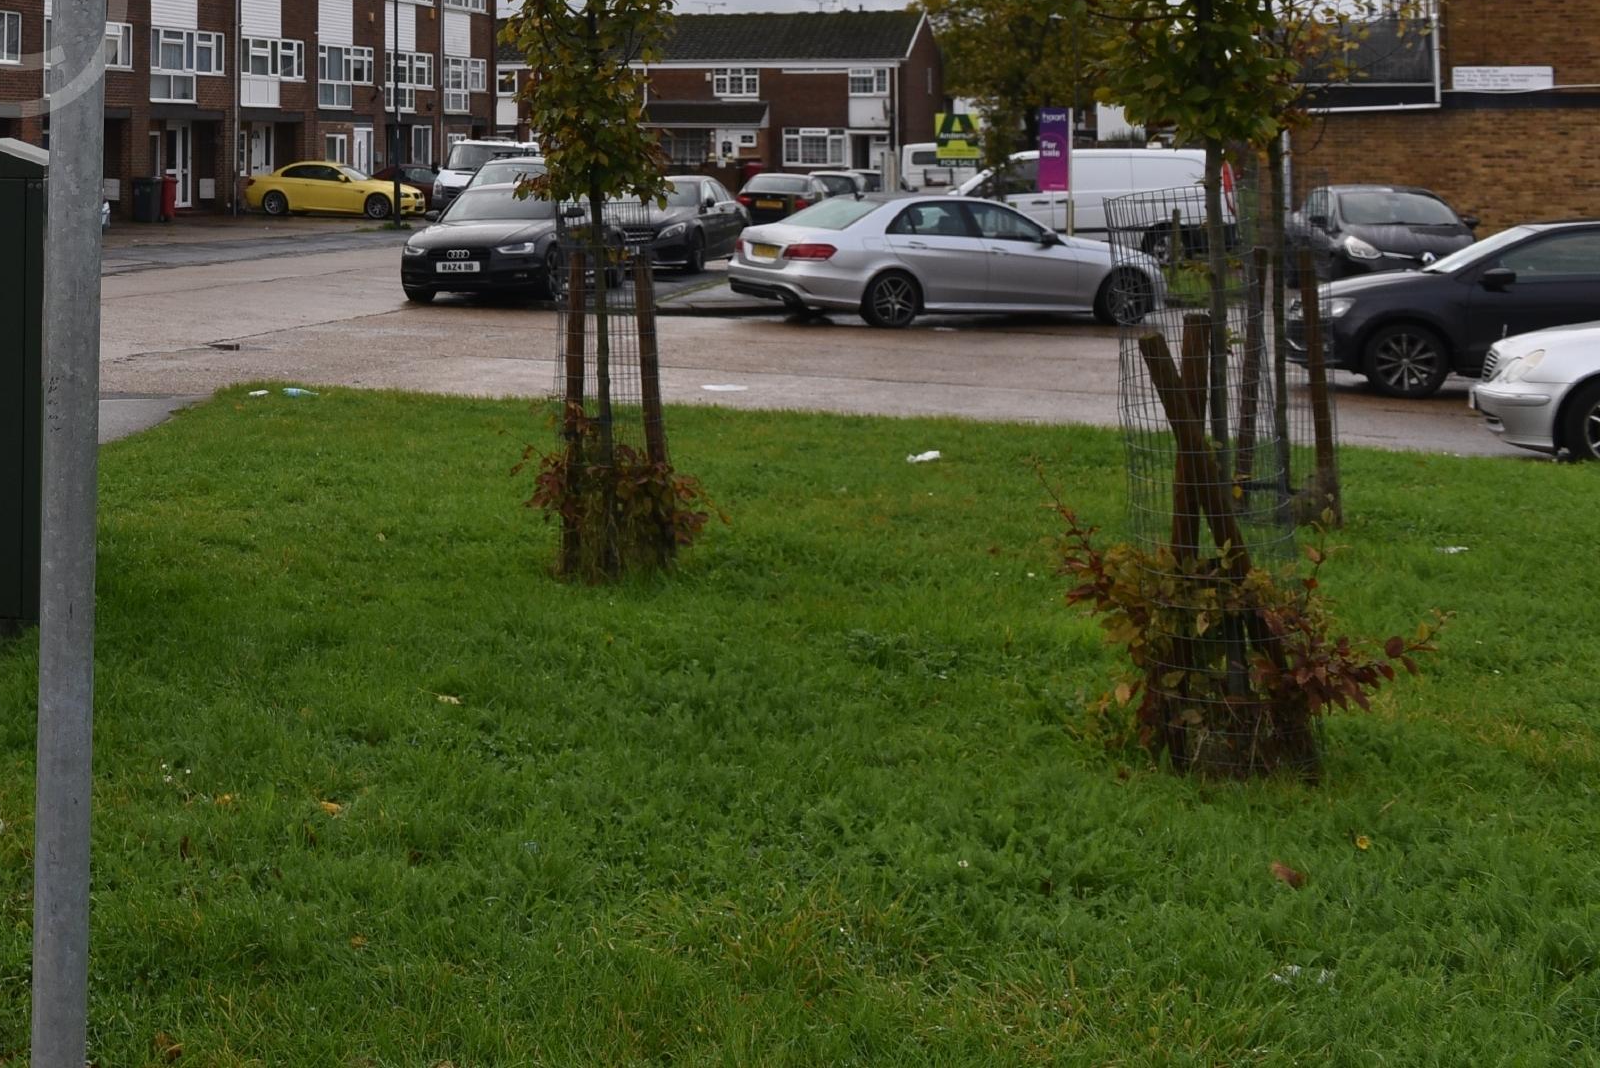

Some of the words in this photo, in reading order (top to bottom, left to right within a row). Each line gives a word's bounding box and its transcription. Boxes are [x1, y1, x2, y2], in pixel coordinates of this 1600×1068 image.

[1041, 140, 1057, 149] For
[1041, 149, 1061, 158] sale
[940, 158, 957, 166] FOR
[958, 158, 977, 167] SALE
